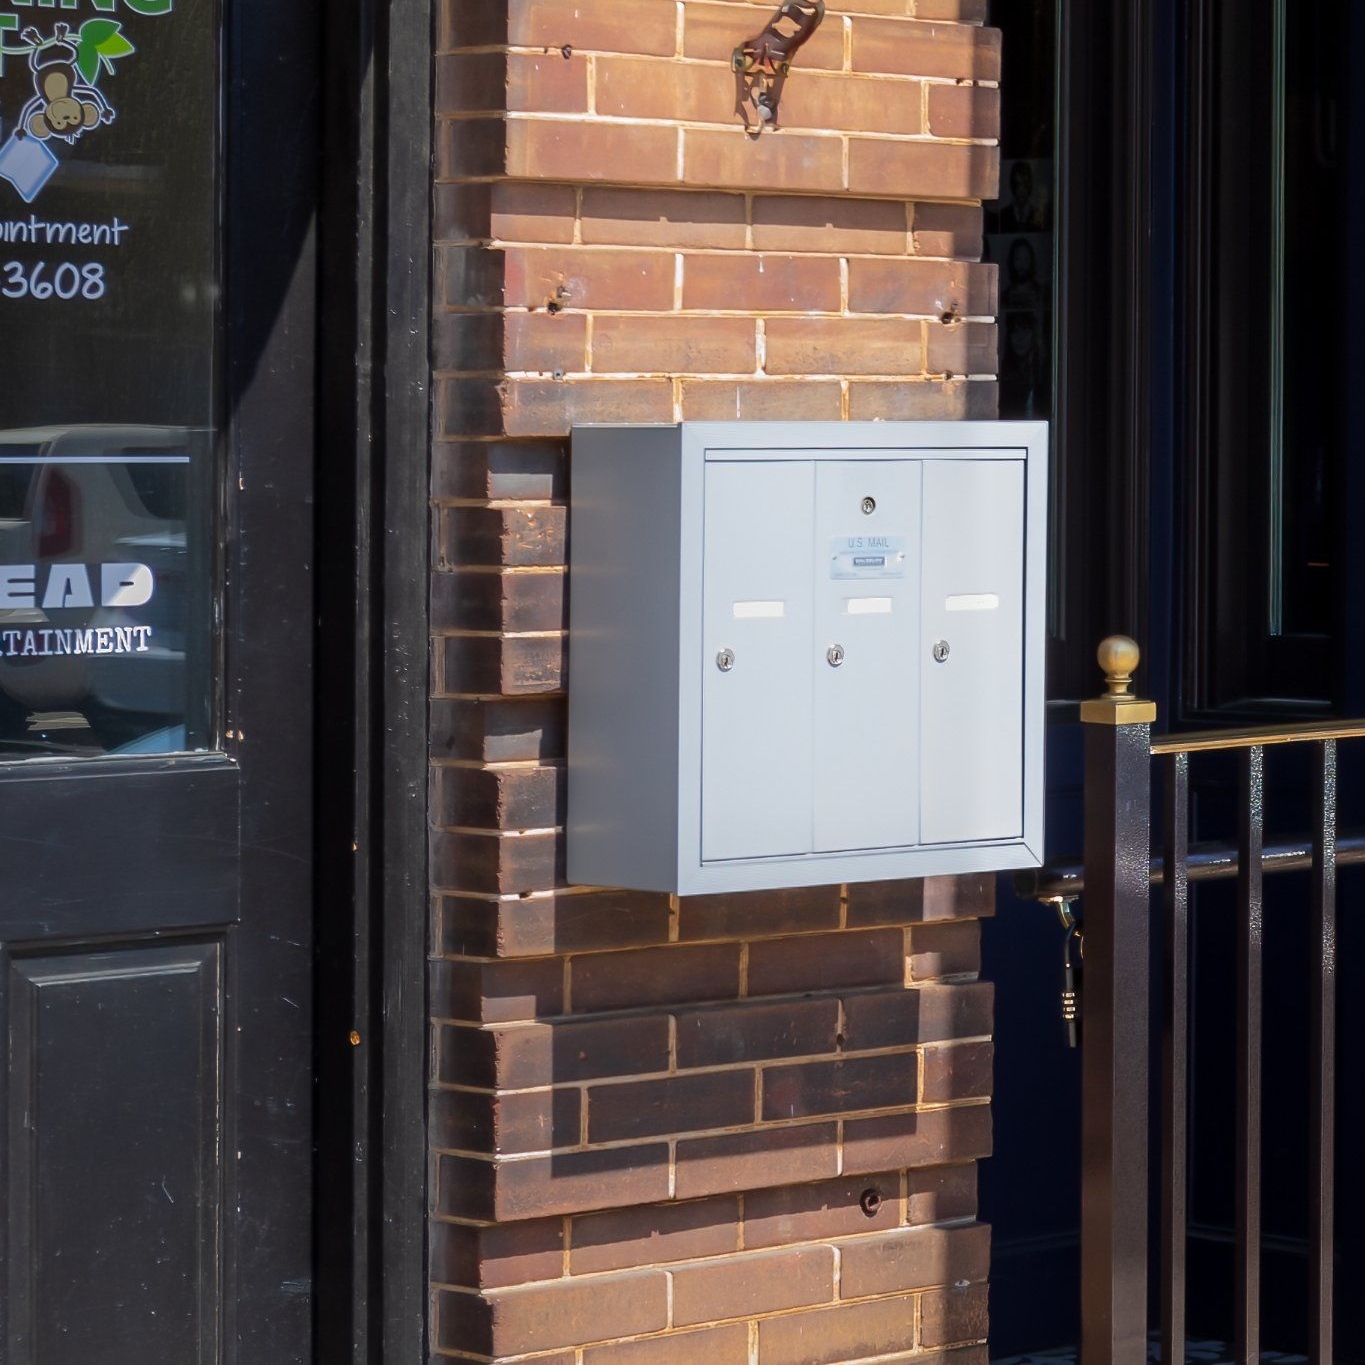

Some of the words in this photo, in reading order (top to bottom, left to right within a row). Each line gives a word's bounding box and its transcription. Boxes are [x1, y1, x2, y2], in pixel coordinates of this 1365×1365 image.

[0, 214, 129, 245] intment
[868, 537, 889, 548] MAIL
[0, 626, 152, 656] TAINMENT
